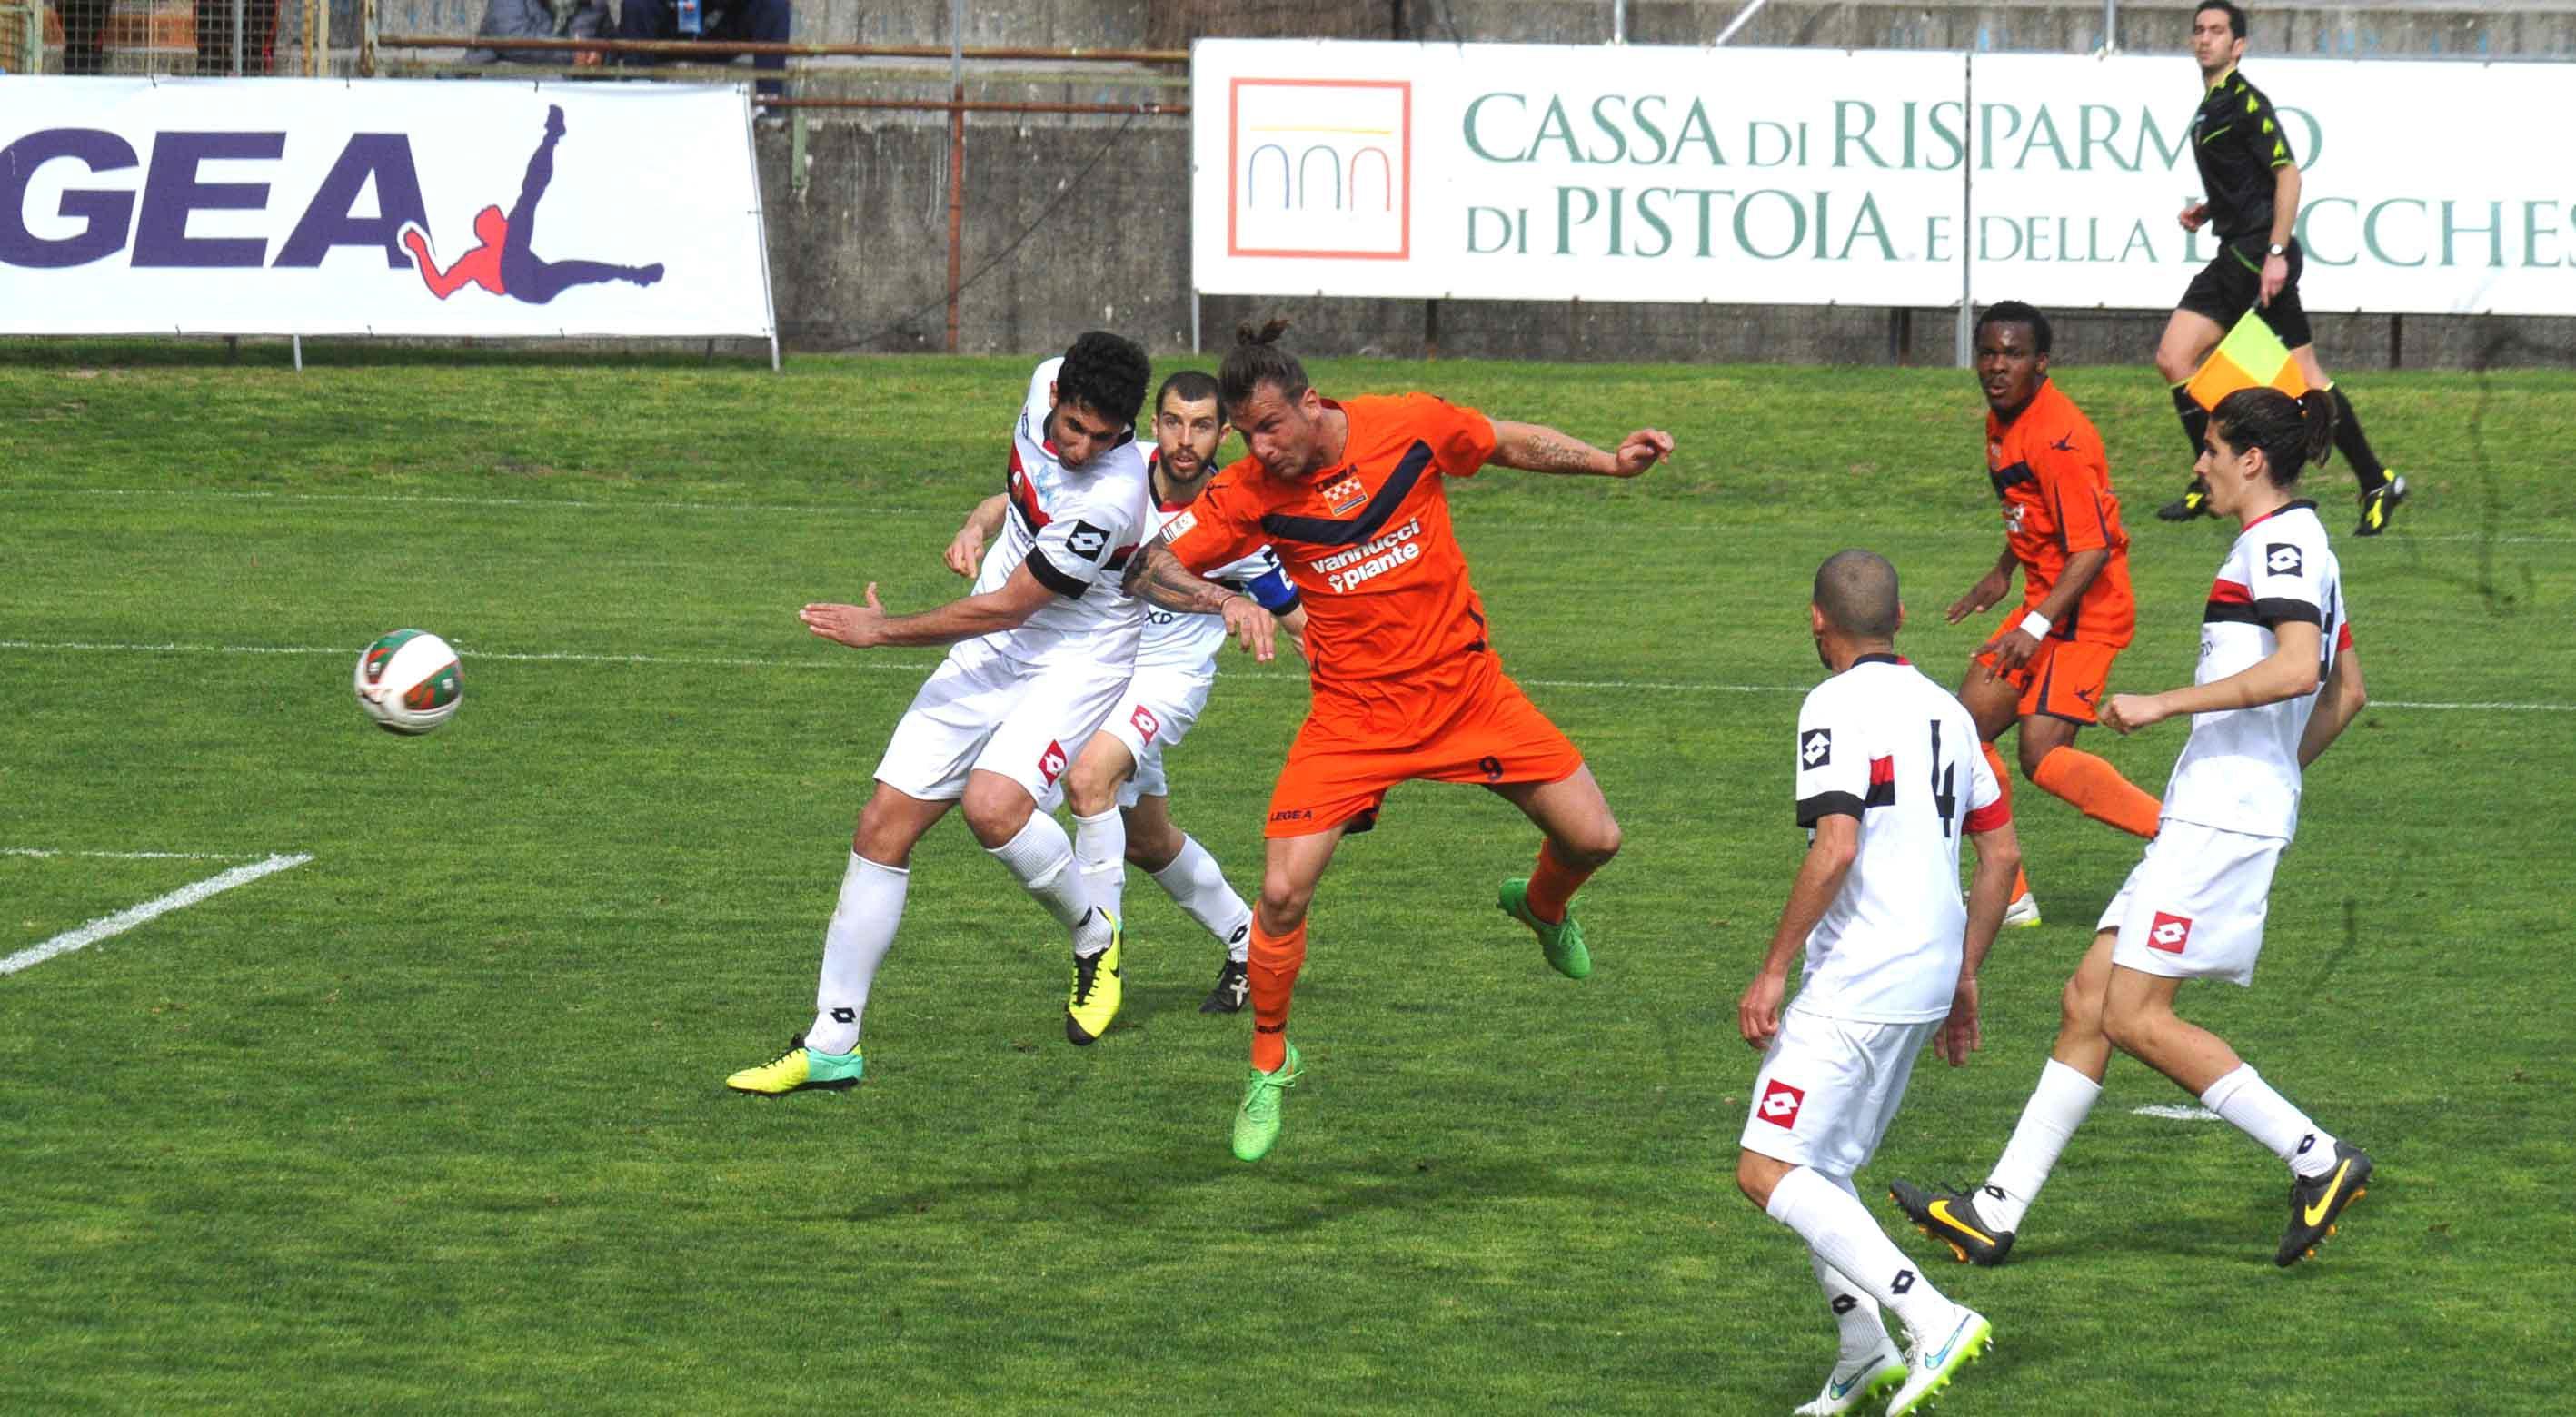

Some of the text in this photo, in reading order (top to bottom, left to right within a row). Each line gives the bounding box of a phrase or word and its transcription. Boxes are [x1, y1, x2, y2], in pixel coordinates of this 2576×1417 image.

[1462, 92, 2323, 172] CASSA DI RISPARMO
[0, 127, 436, 270] GEA
[1466, 205, 1529, 254] DI
[1552, 184, 1905, 262] PISTOIA
[1925, 215, 1953, 262] E
[1978, 216, 2159, 263] DELLA
[1310, 516, 1421, 574] vannucci
[1478, 755, 1504, 782] 9
[1929, 718, 1956, 838] 4
